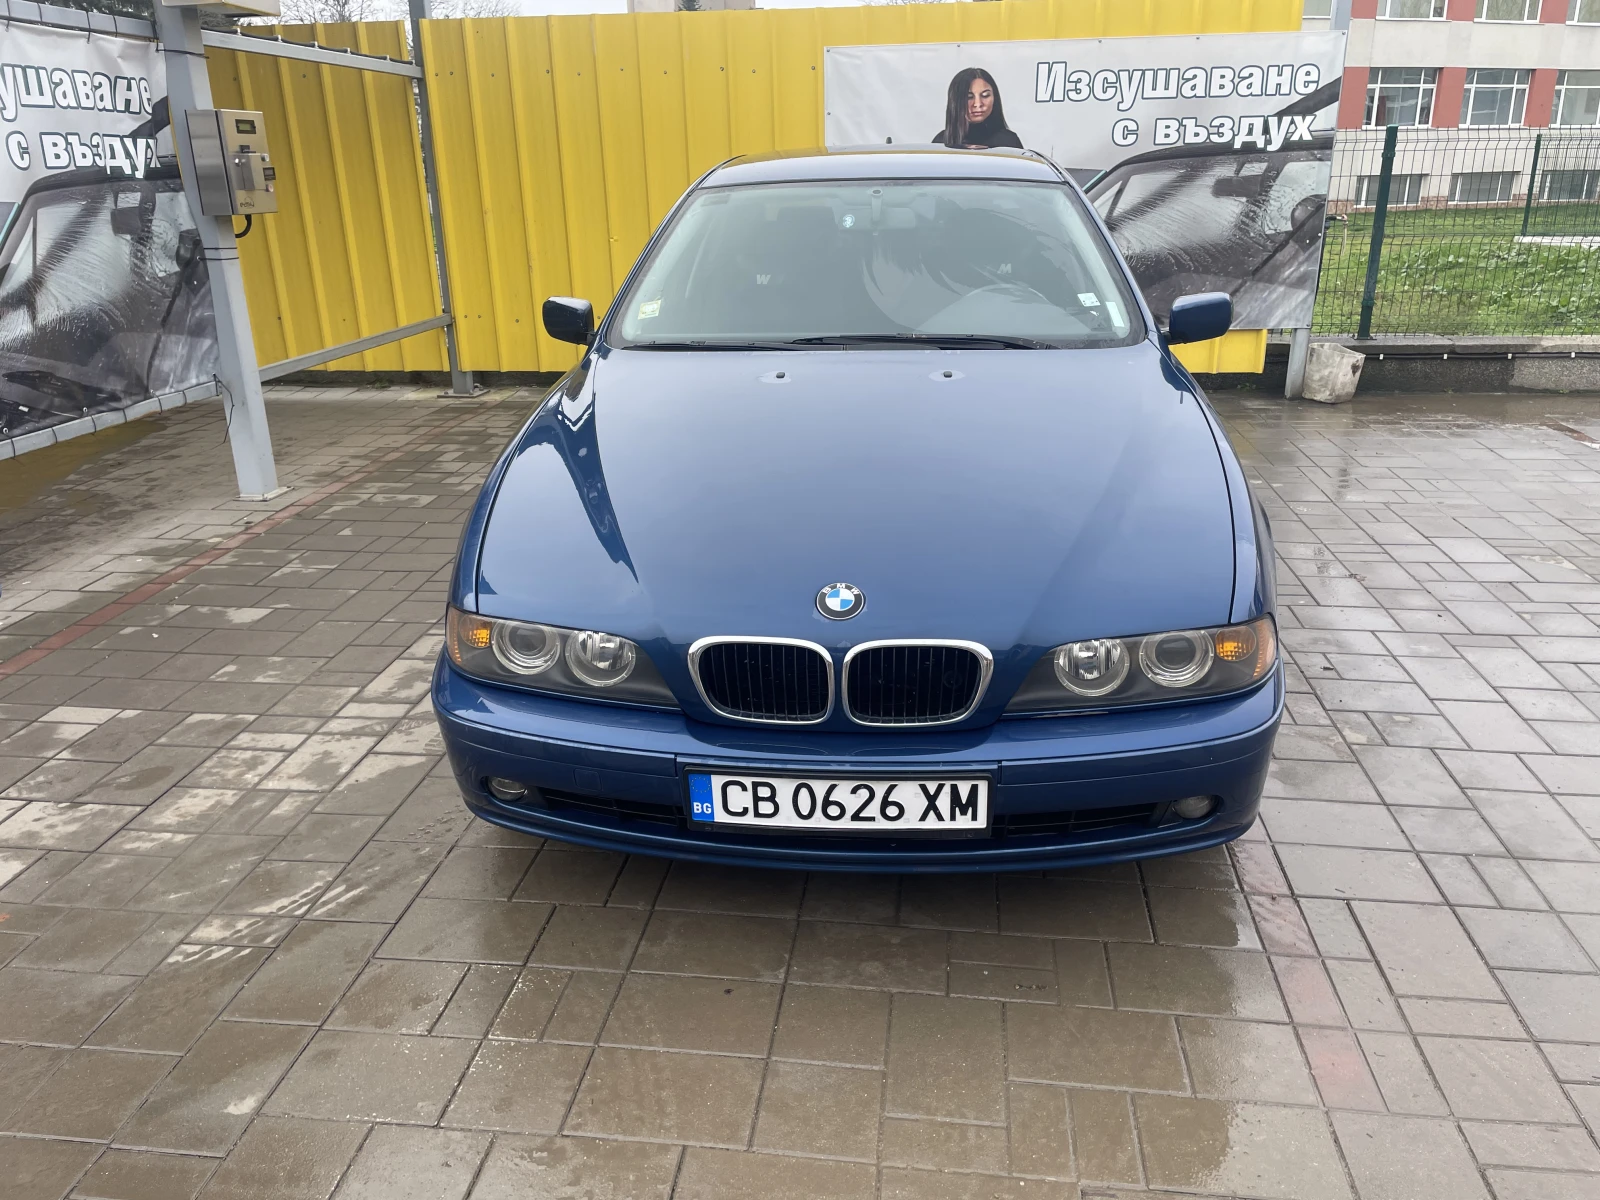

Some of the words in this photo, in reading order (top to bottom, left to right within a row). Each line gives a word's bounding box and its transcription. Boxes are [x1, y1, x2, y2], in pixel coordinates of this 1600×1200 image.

[1035, 61, 1320, 112] Изсушаване
[5, 130, 31, 171] с
[1111, 117, 1138, 147] с
[1153, 113, 1317, 151] въздух
[821, 582, 861, 595] BMW
[693, 801, 712, 814] BG
[720, 779, 780, 819] CB
[791, 781, 906, 822] 0626
[917, 782, 979, 822] XM
